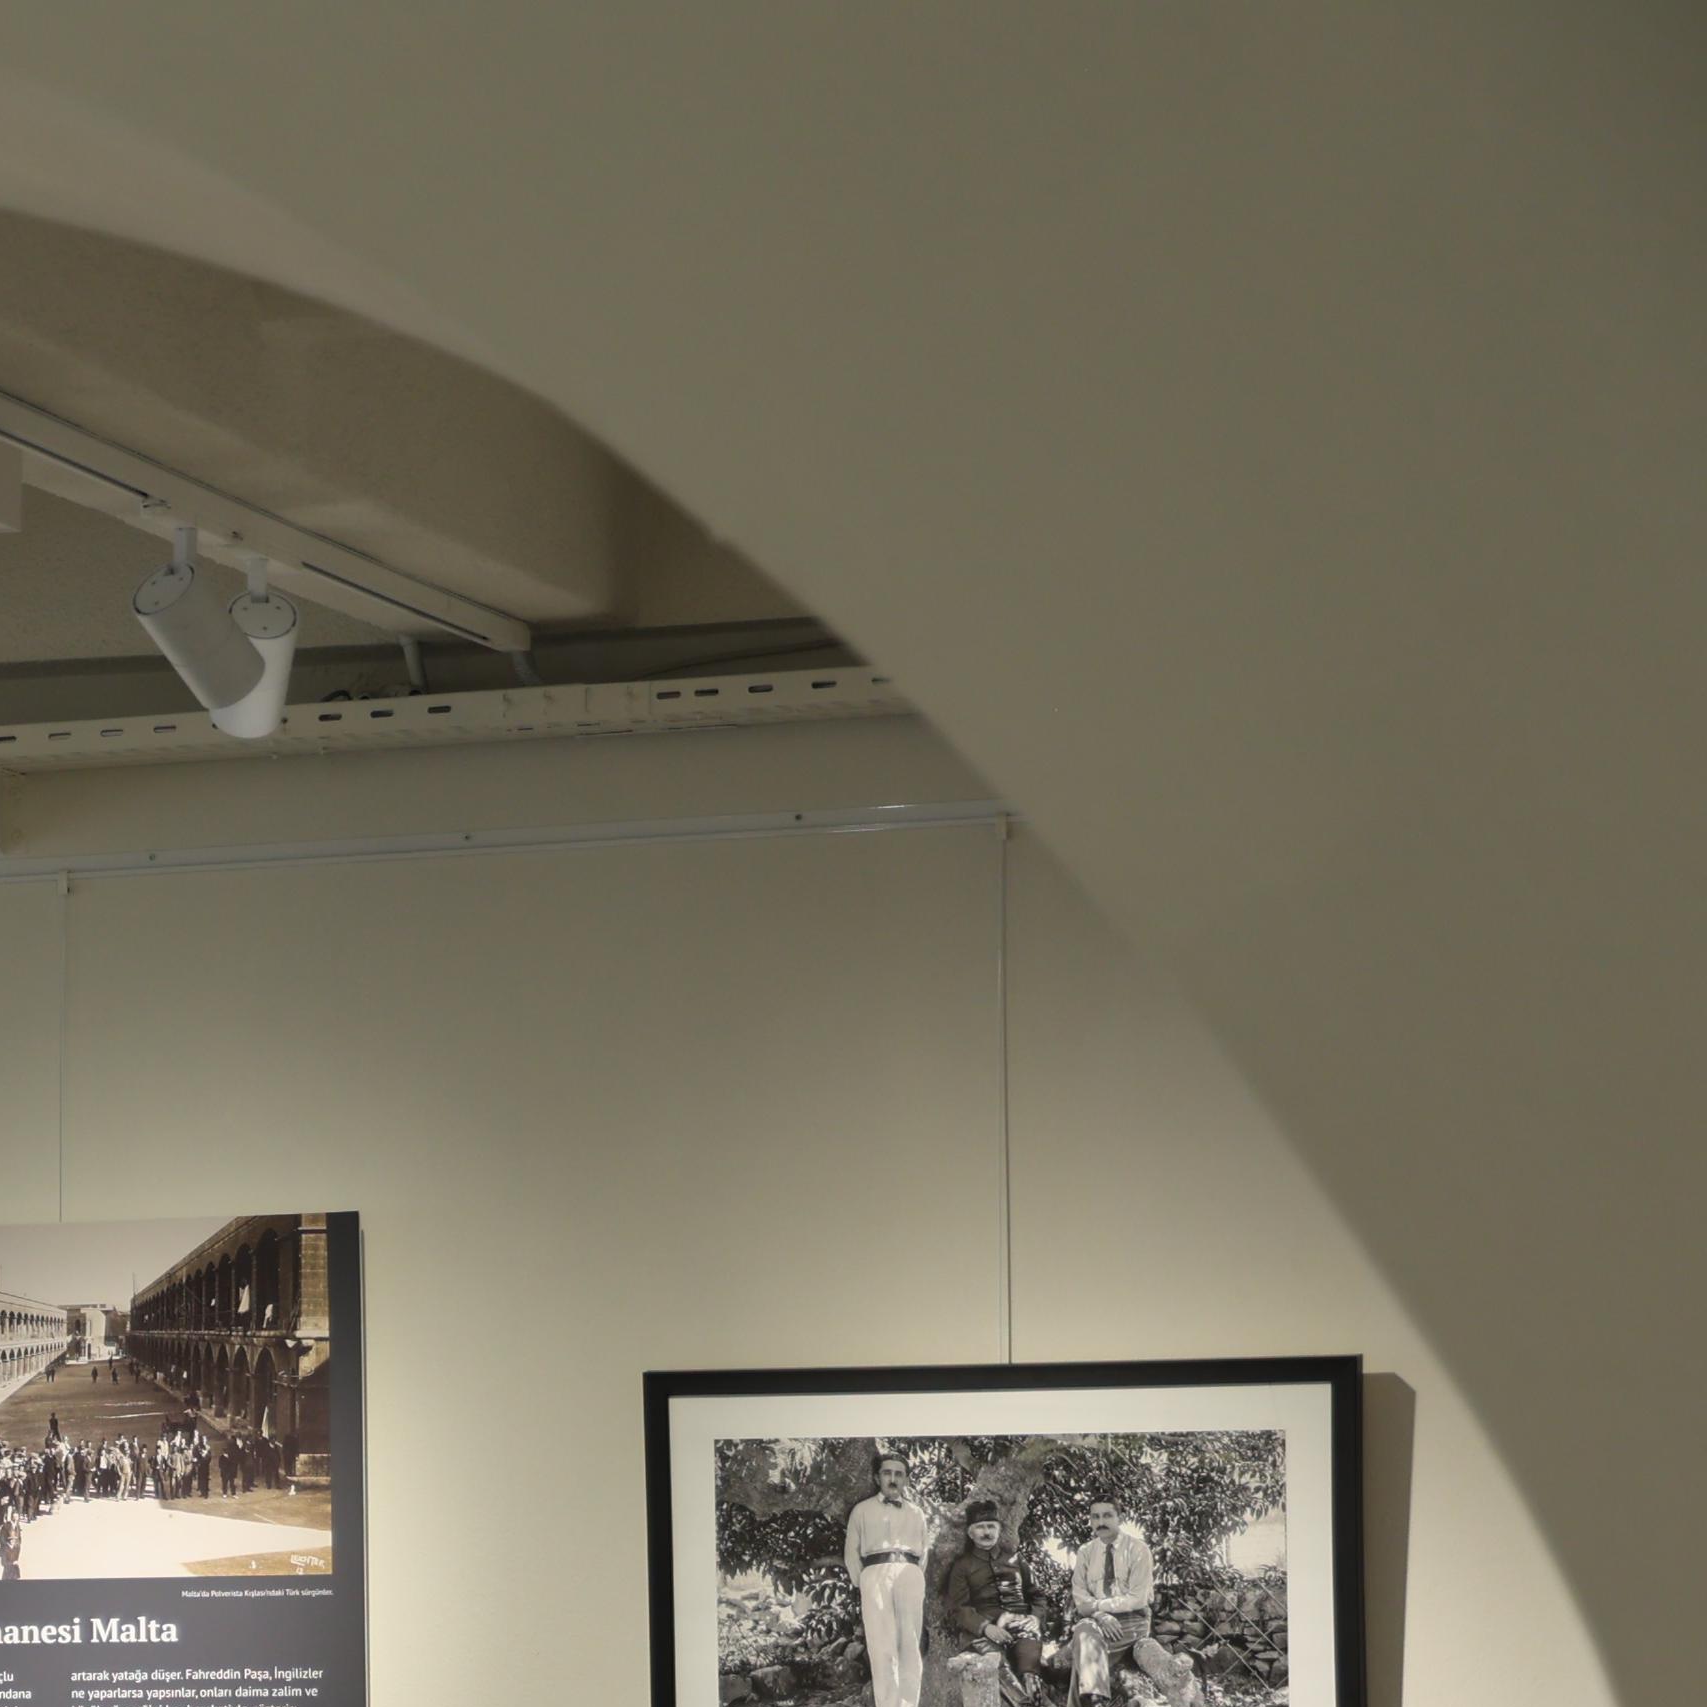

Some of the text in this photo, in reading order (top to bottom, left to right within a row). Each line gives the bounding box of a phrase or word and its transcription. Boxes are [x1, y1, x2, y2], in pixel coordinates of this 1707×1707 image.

[90, 1615, 178, 1643] Malta
[71, 1665, 323, 1683] artarak yatağa düşer. Fahreddin Paşa, İngilizler
[71, 1685, 319, 1701] ne yaparlarsa yapsınlar, onları daima zalim ve
